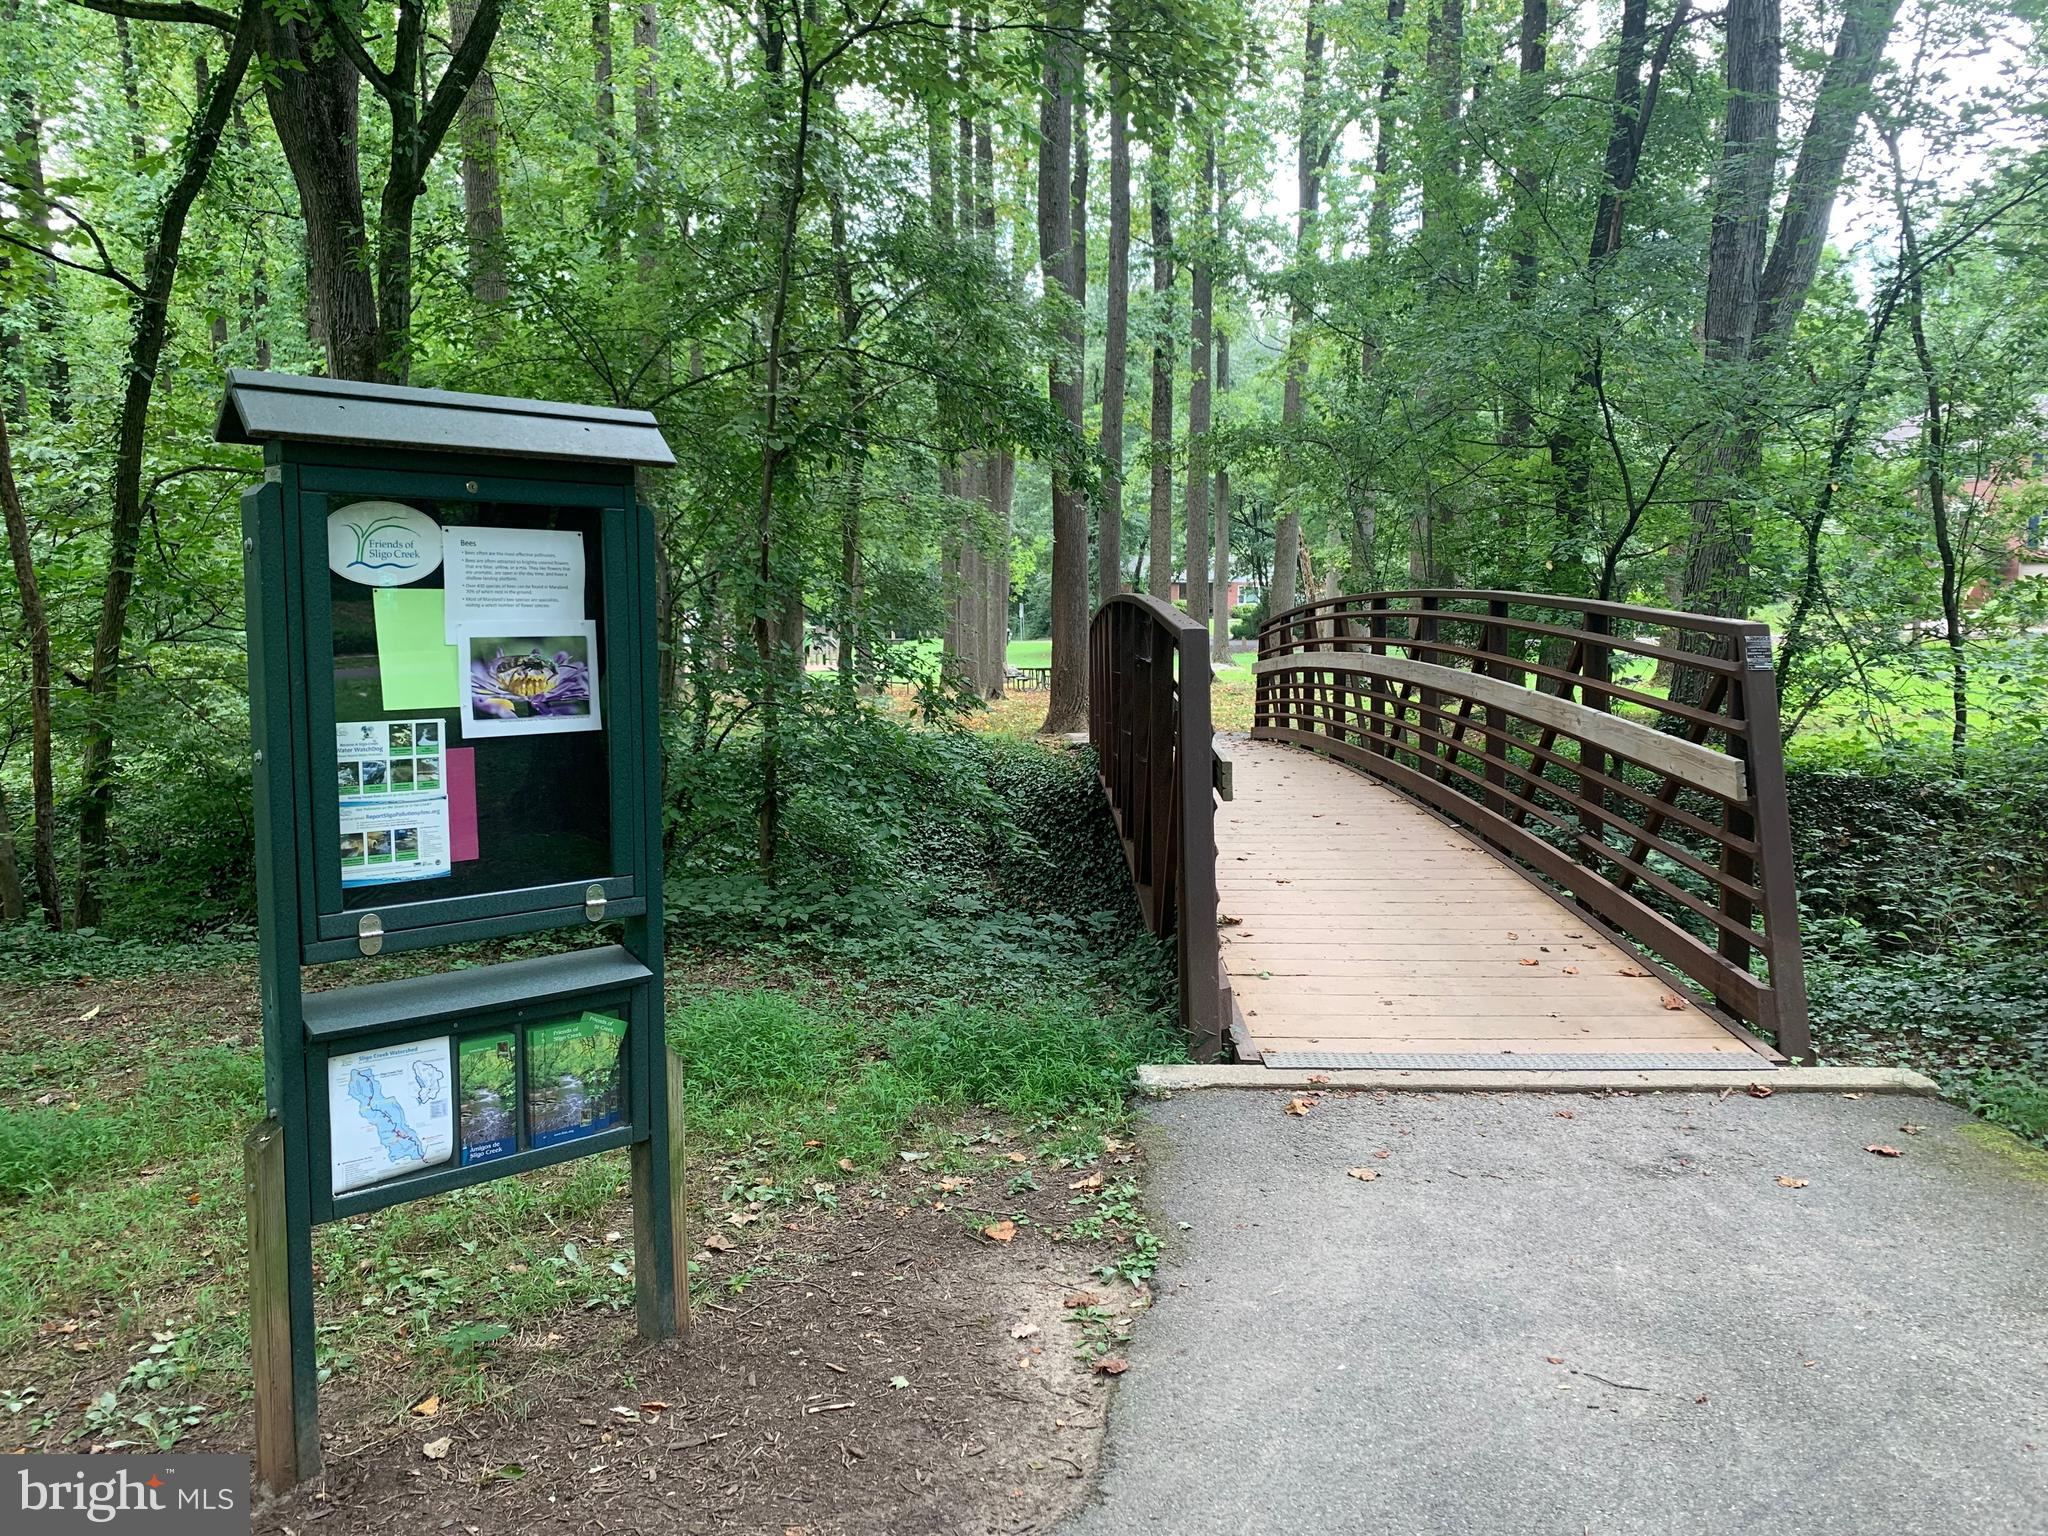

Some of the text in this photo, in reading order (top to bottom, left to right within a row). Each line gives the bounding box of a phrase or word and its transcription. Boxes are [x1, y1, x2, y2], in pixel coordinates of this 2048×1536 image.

[369, 540, 414, 549] Friends of
[369, 549, 421, 560] Sligo Creek
[553, 1028, 572, 1036] Friends
[470, 1144, 492, 1153] Amigos
[470, 1150, 484, 1158] Sligo
